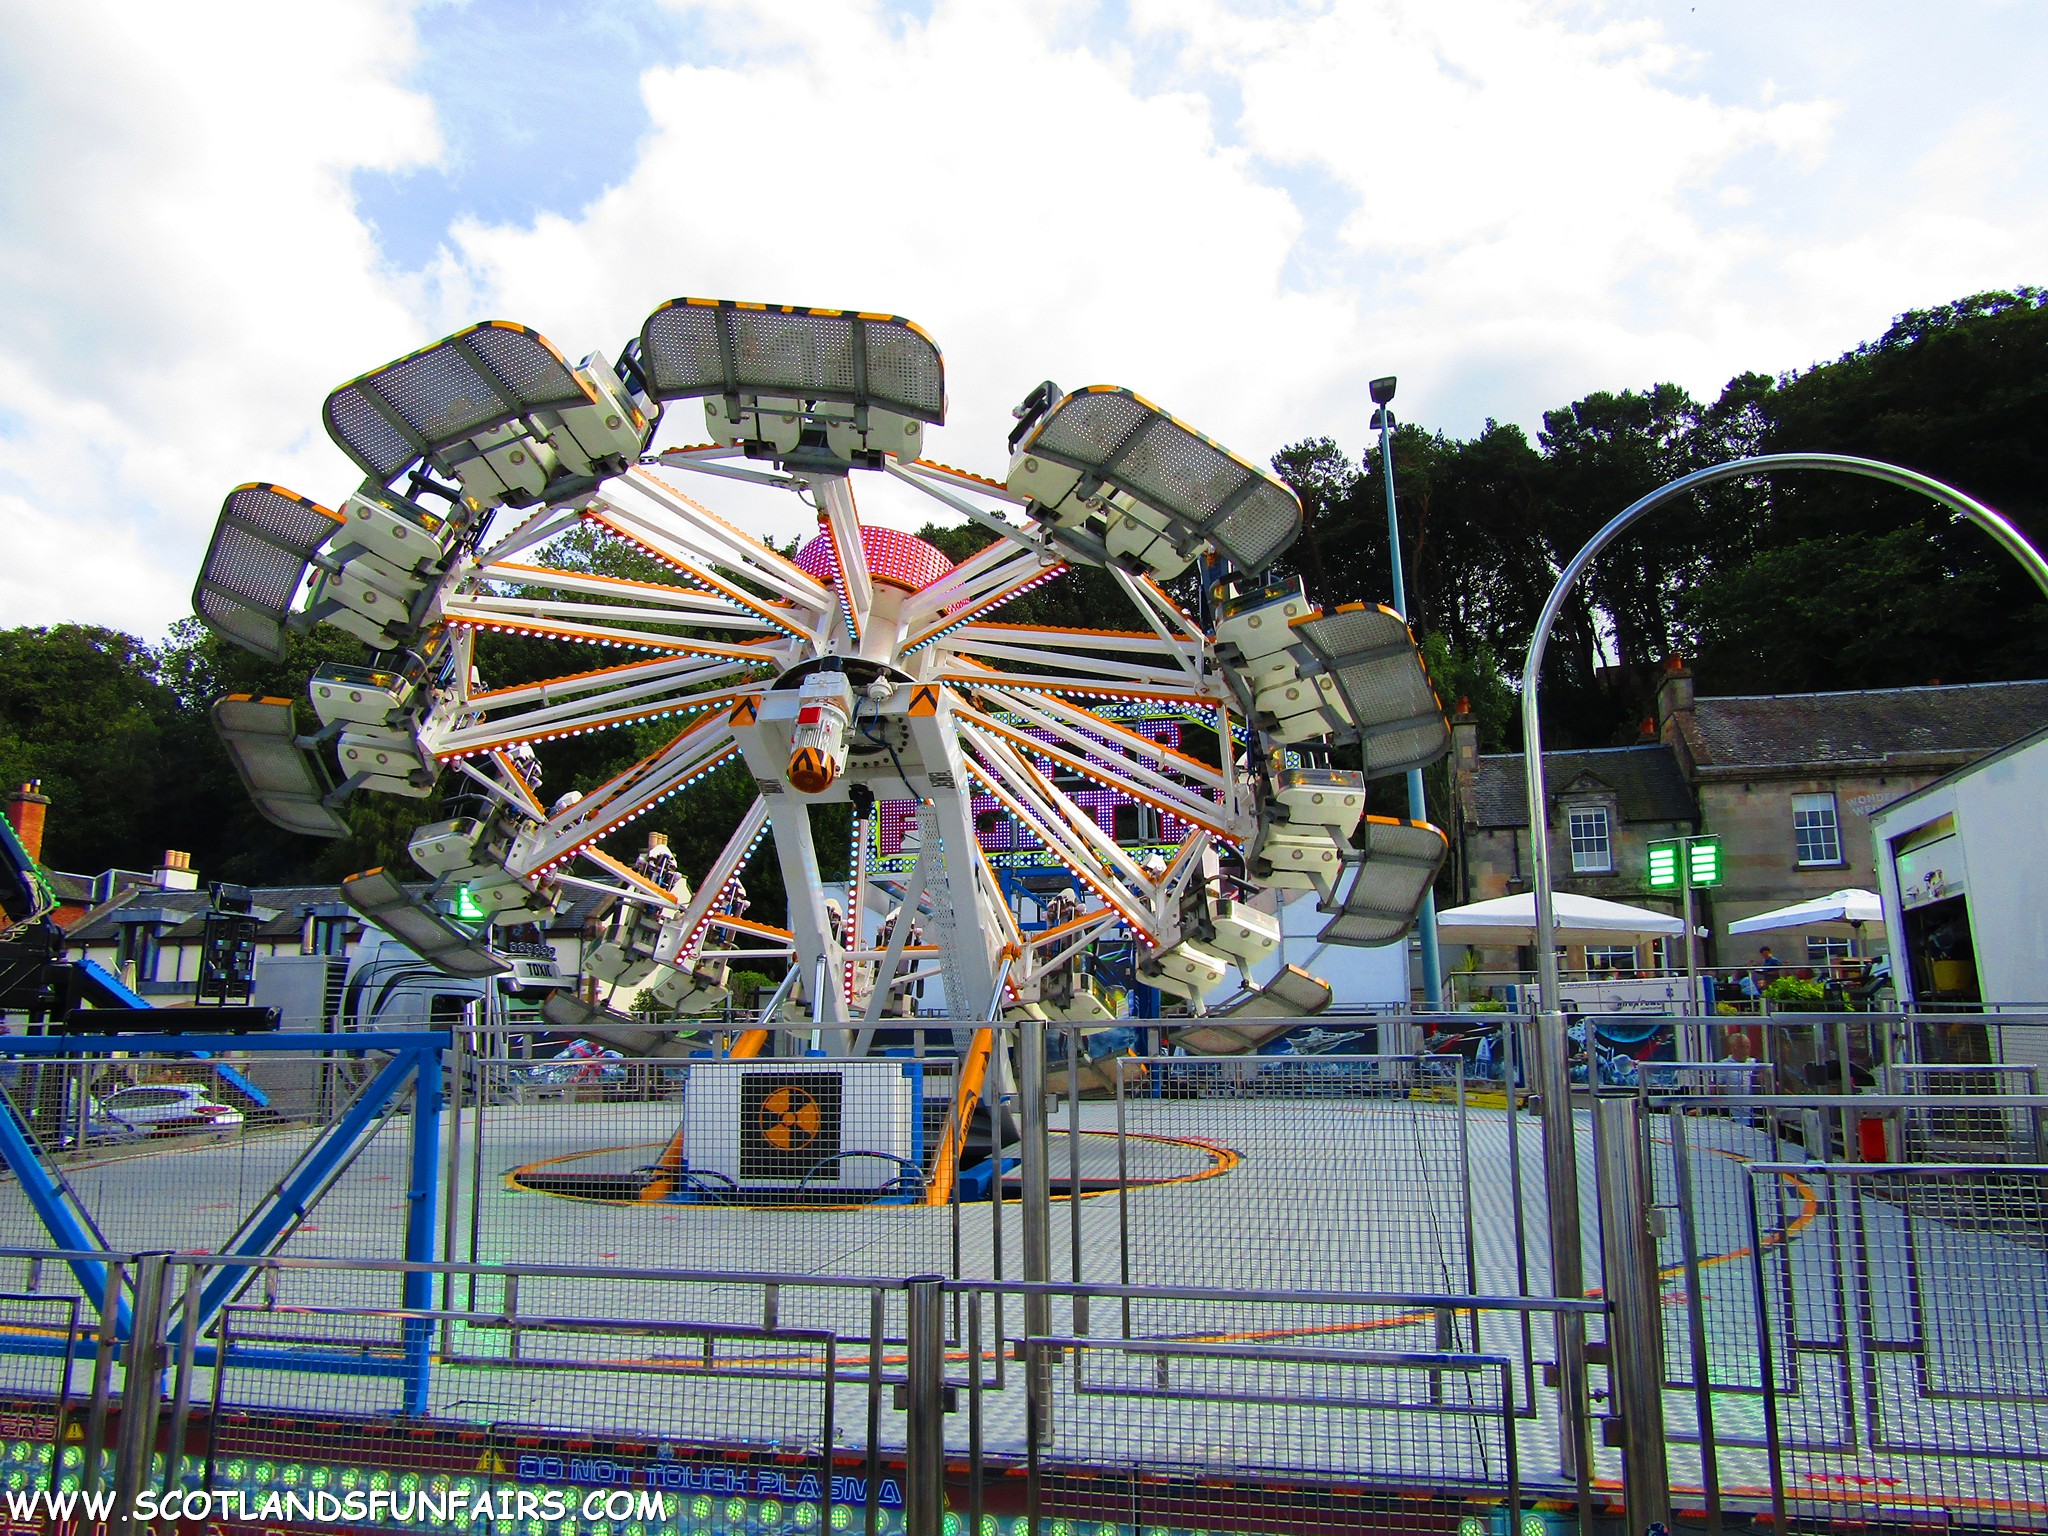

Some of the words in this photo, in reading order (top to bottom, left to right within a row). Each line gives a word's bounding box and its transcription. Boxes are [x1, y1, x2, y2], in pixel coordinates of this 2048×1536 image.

[526, 963, 552, 977] TOXIC
[519, 1455, 563, 1481] DO
[570, 1458, 633, 1484] NOT
[643, 1463, 748, 1493] TOUCH
[757, 1470, 902, 1504] PLASMA
